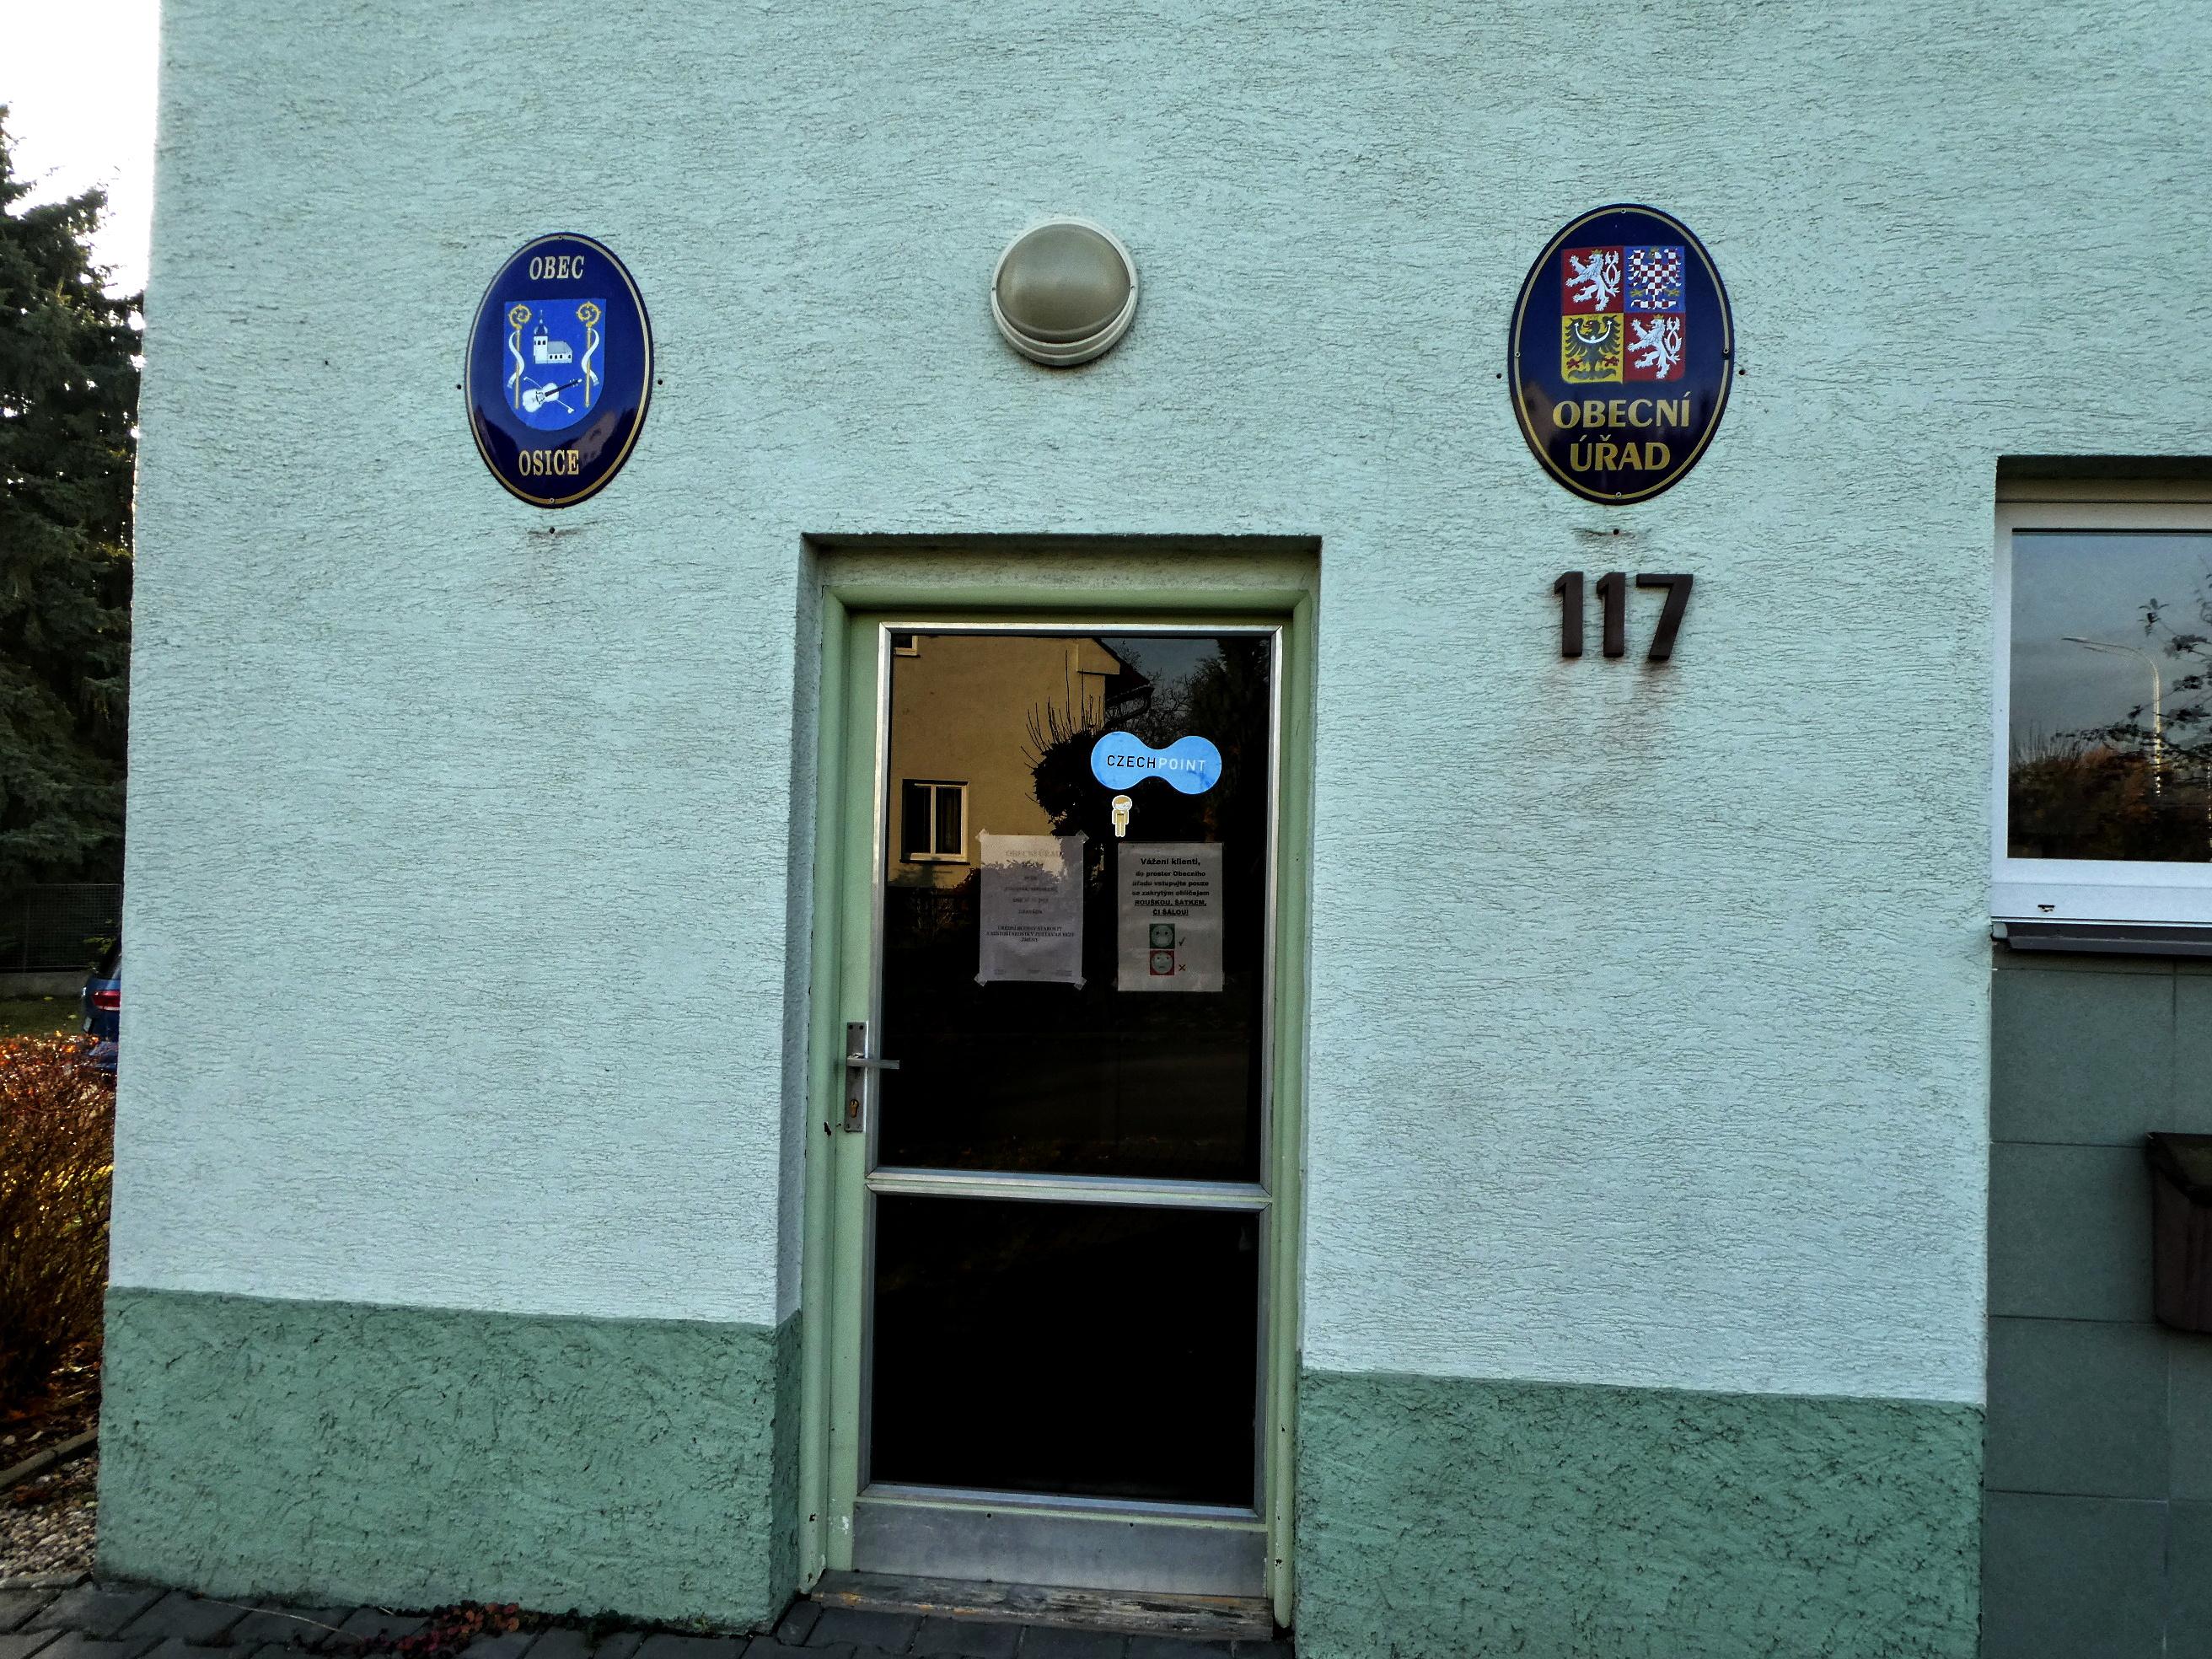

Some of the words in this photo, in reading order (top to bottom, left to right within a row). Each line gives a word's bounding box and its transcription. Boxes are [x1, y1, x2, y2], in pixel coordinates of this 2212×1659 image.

[529, 255, 584, 280] OBEC
[1552, 391, 1691, 429] OBECNÍ
[518, 449, 580, 476] OSICE
[1570, 435, 1671, 472] ÚŘAD
[1554, 572, 1694, 661] 117
[1172, 857, 1200, 866] klienti,
